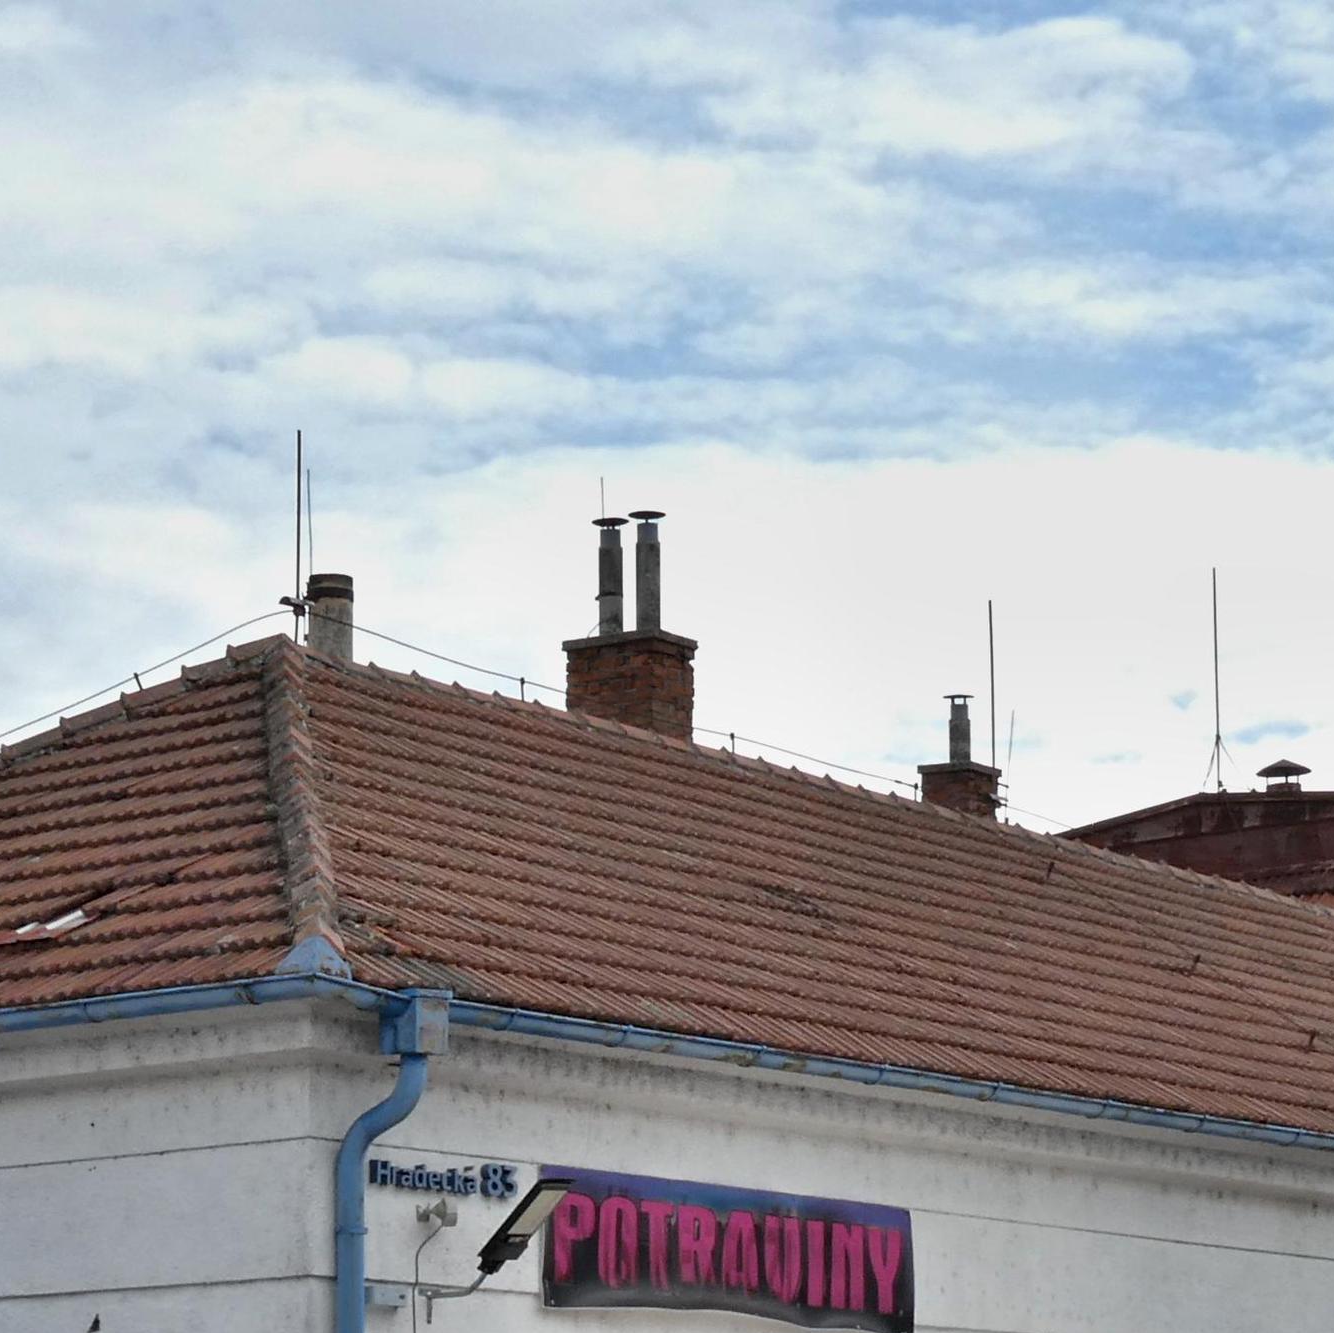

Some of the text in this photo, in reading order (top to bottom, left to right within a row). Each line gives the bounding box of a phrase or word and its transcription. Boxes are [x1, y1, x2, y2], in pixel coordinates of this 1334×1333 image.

[369, 1159, 519, 1197] Hradecká 83
[552, 1191, 903, 1315] POTRAVINY
